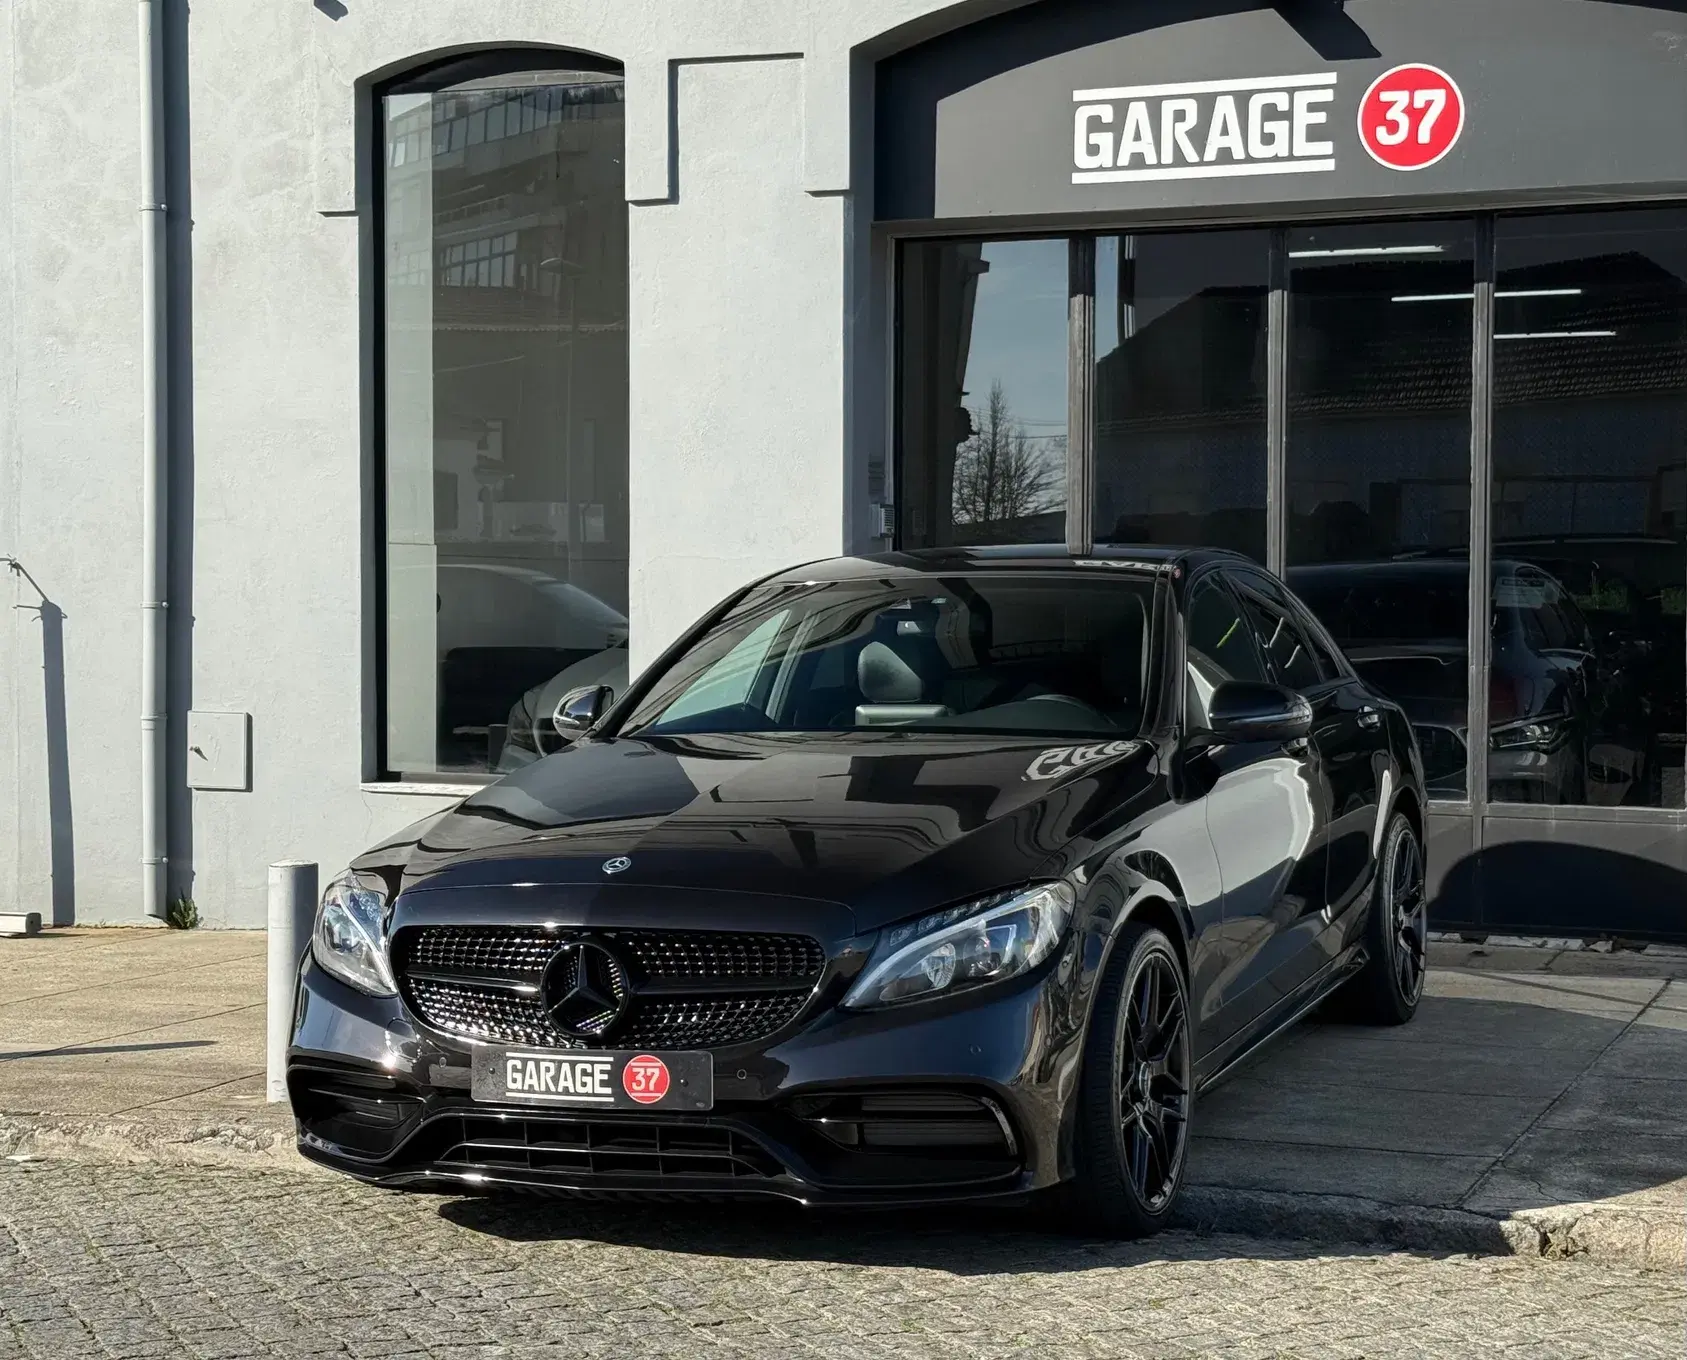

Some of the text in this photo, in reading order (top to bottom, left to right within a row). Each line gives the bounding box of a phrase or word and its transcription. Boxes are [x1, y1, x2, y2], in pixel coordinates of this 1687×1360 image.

[1073, 88, 1447, 169] GARAGE 37
[506, 1058, 661, 1095] GARAGE 37
